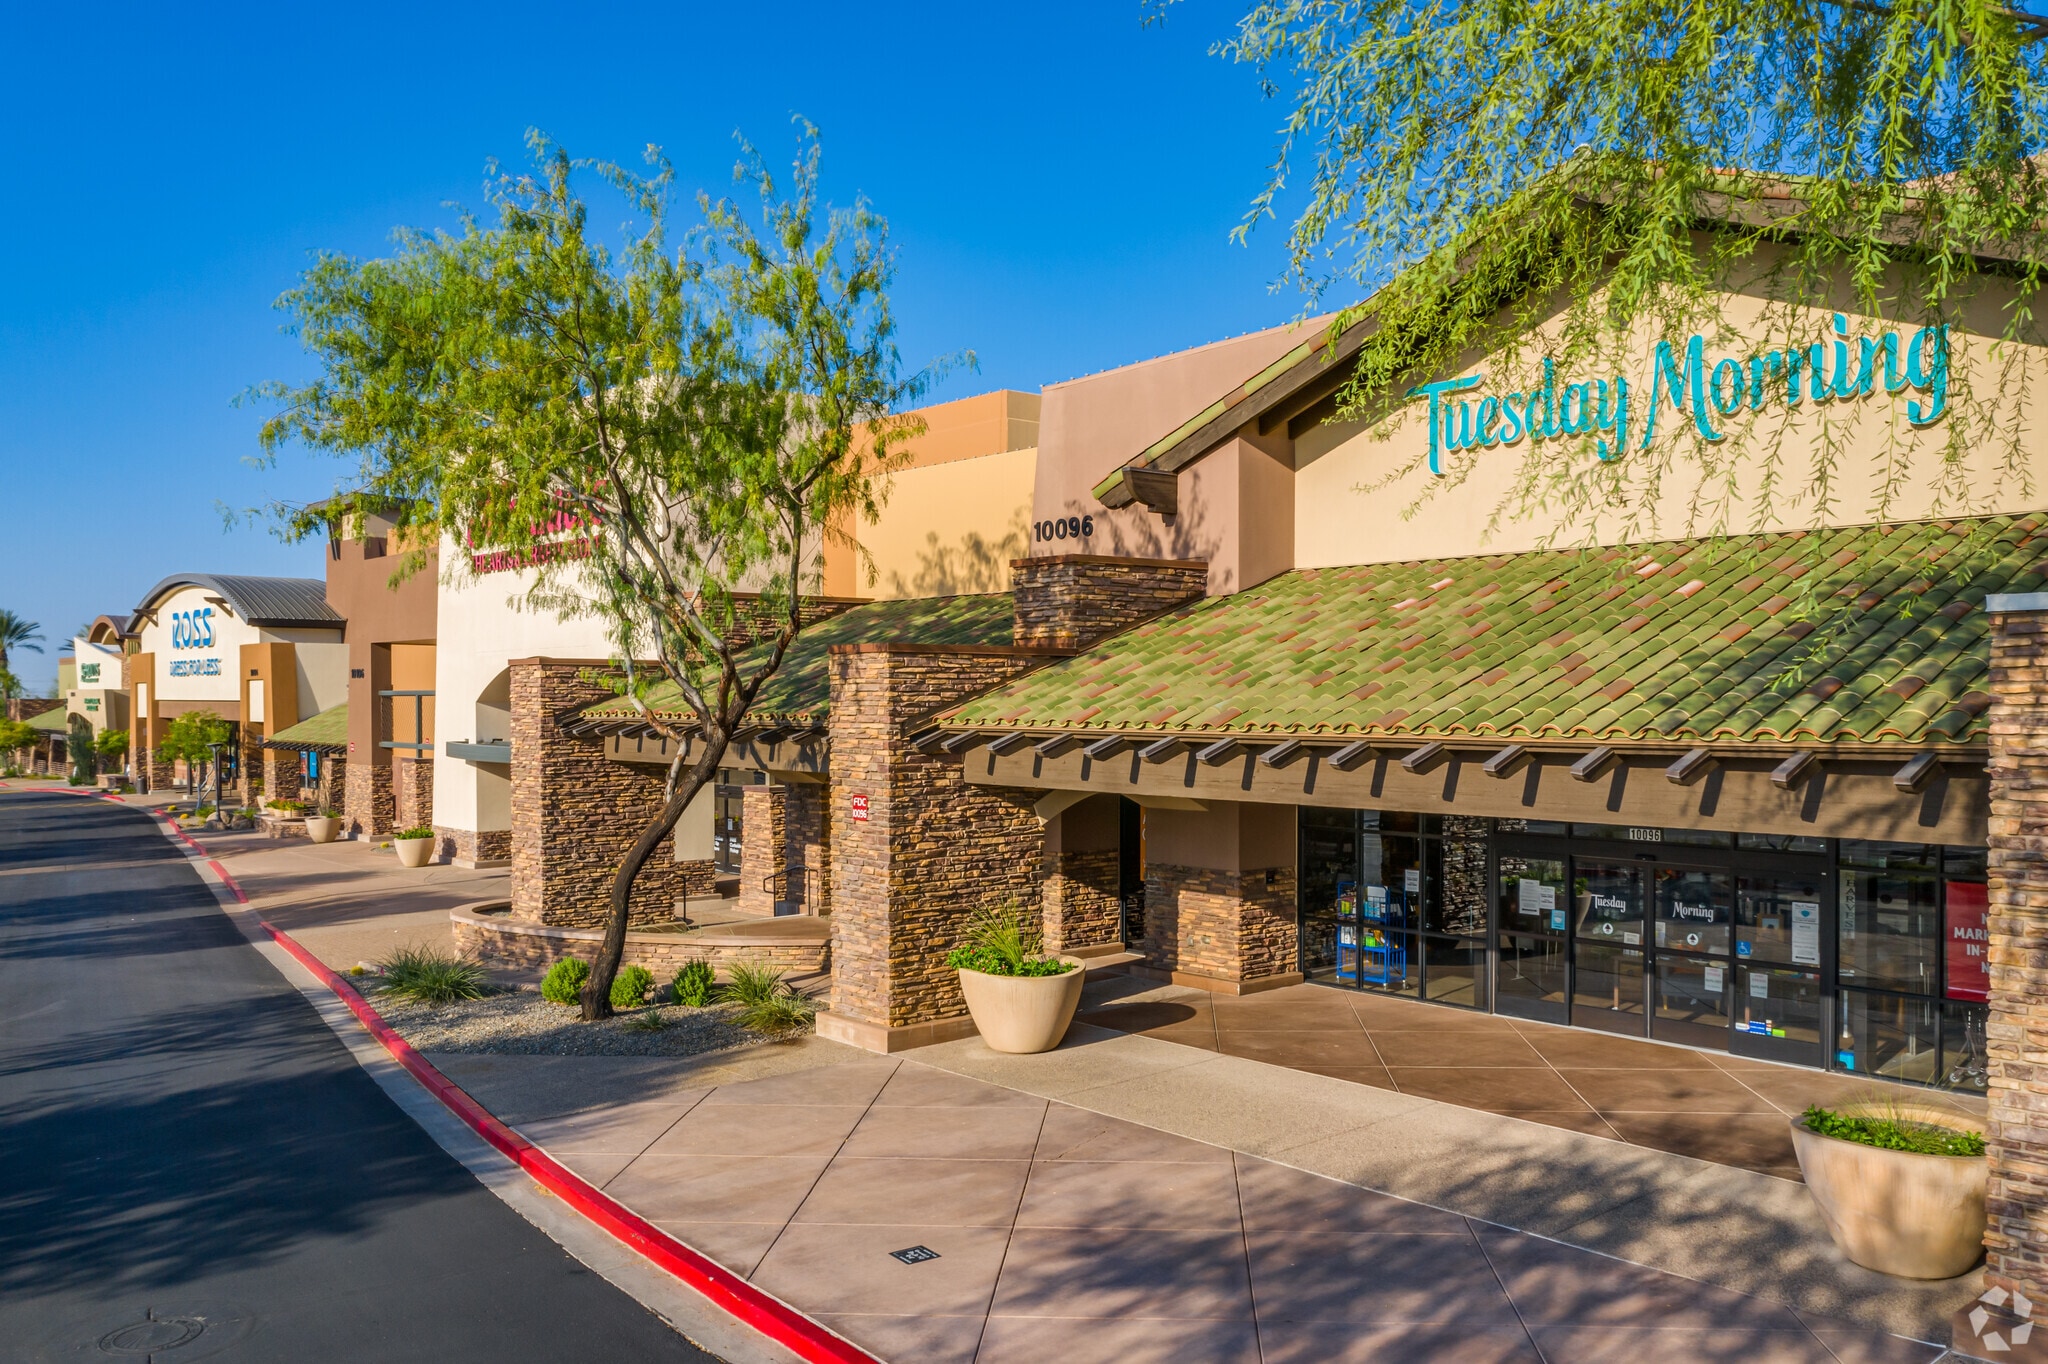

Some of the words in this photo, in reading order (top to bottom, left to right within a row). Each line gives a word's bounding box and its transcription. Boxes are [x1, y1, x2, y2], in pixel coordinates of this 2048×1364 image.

[1403, 356, 1628, 475] Tuesday
[1639, 313, 1951, 450] Morning
[1034, 515, 1093, 542] 10096
[173, 608, 214, 649] ROSS
[853, 797, 867, 807] FDC
[852, 809, 867, 819] 10096
[1631, 829, 1660, 841] 10096
[1591, 893, 1626, 913] Tuesday
[1672, 901, 1714, 923] Morning
